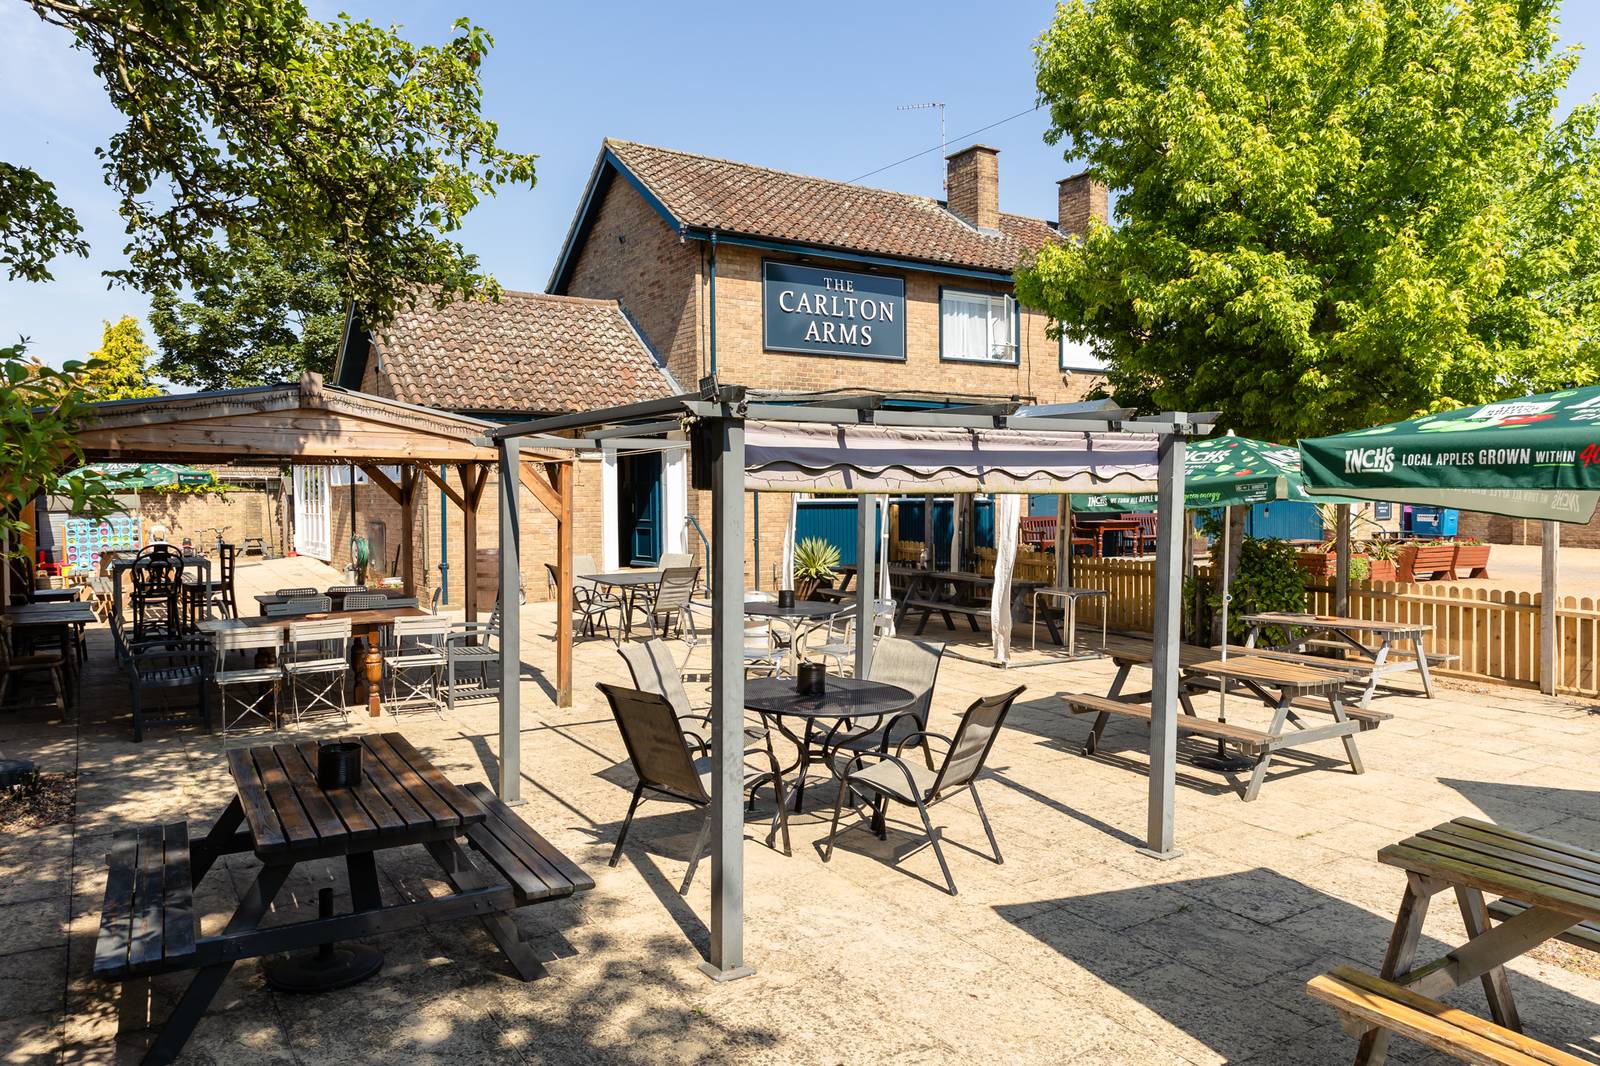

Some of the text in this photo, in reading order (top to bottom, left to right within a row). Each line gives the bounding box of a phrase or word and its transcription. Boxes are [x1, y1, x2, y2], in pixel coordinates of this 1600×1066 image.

[824, 277, 854, 292] THE
[779, 290, 895, 322] CARLTON
[804, 320, 872, 346] ARMS
[1401, 453, 1433, 466] LOCAL
[1436, 452, 1475, 466] APPLES
[1478, 448, 1531, 465] GROWN
[1535, 450, 1576, 463] WITHIN
